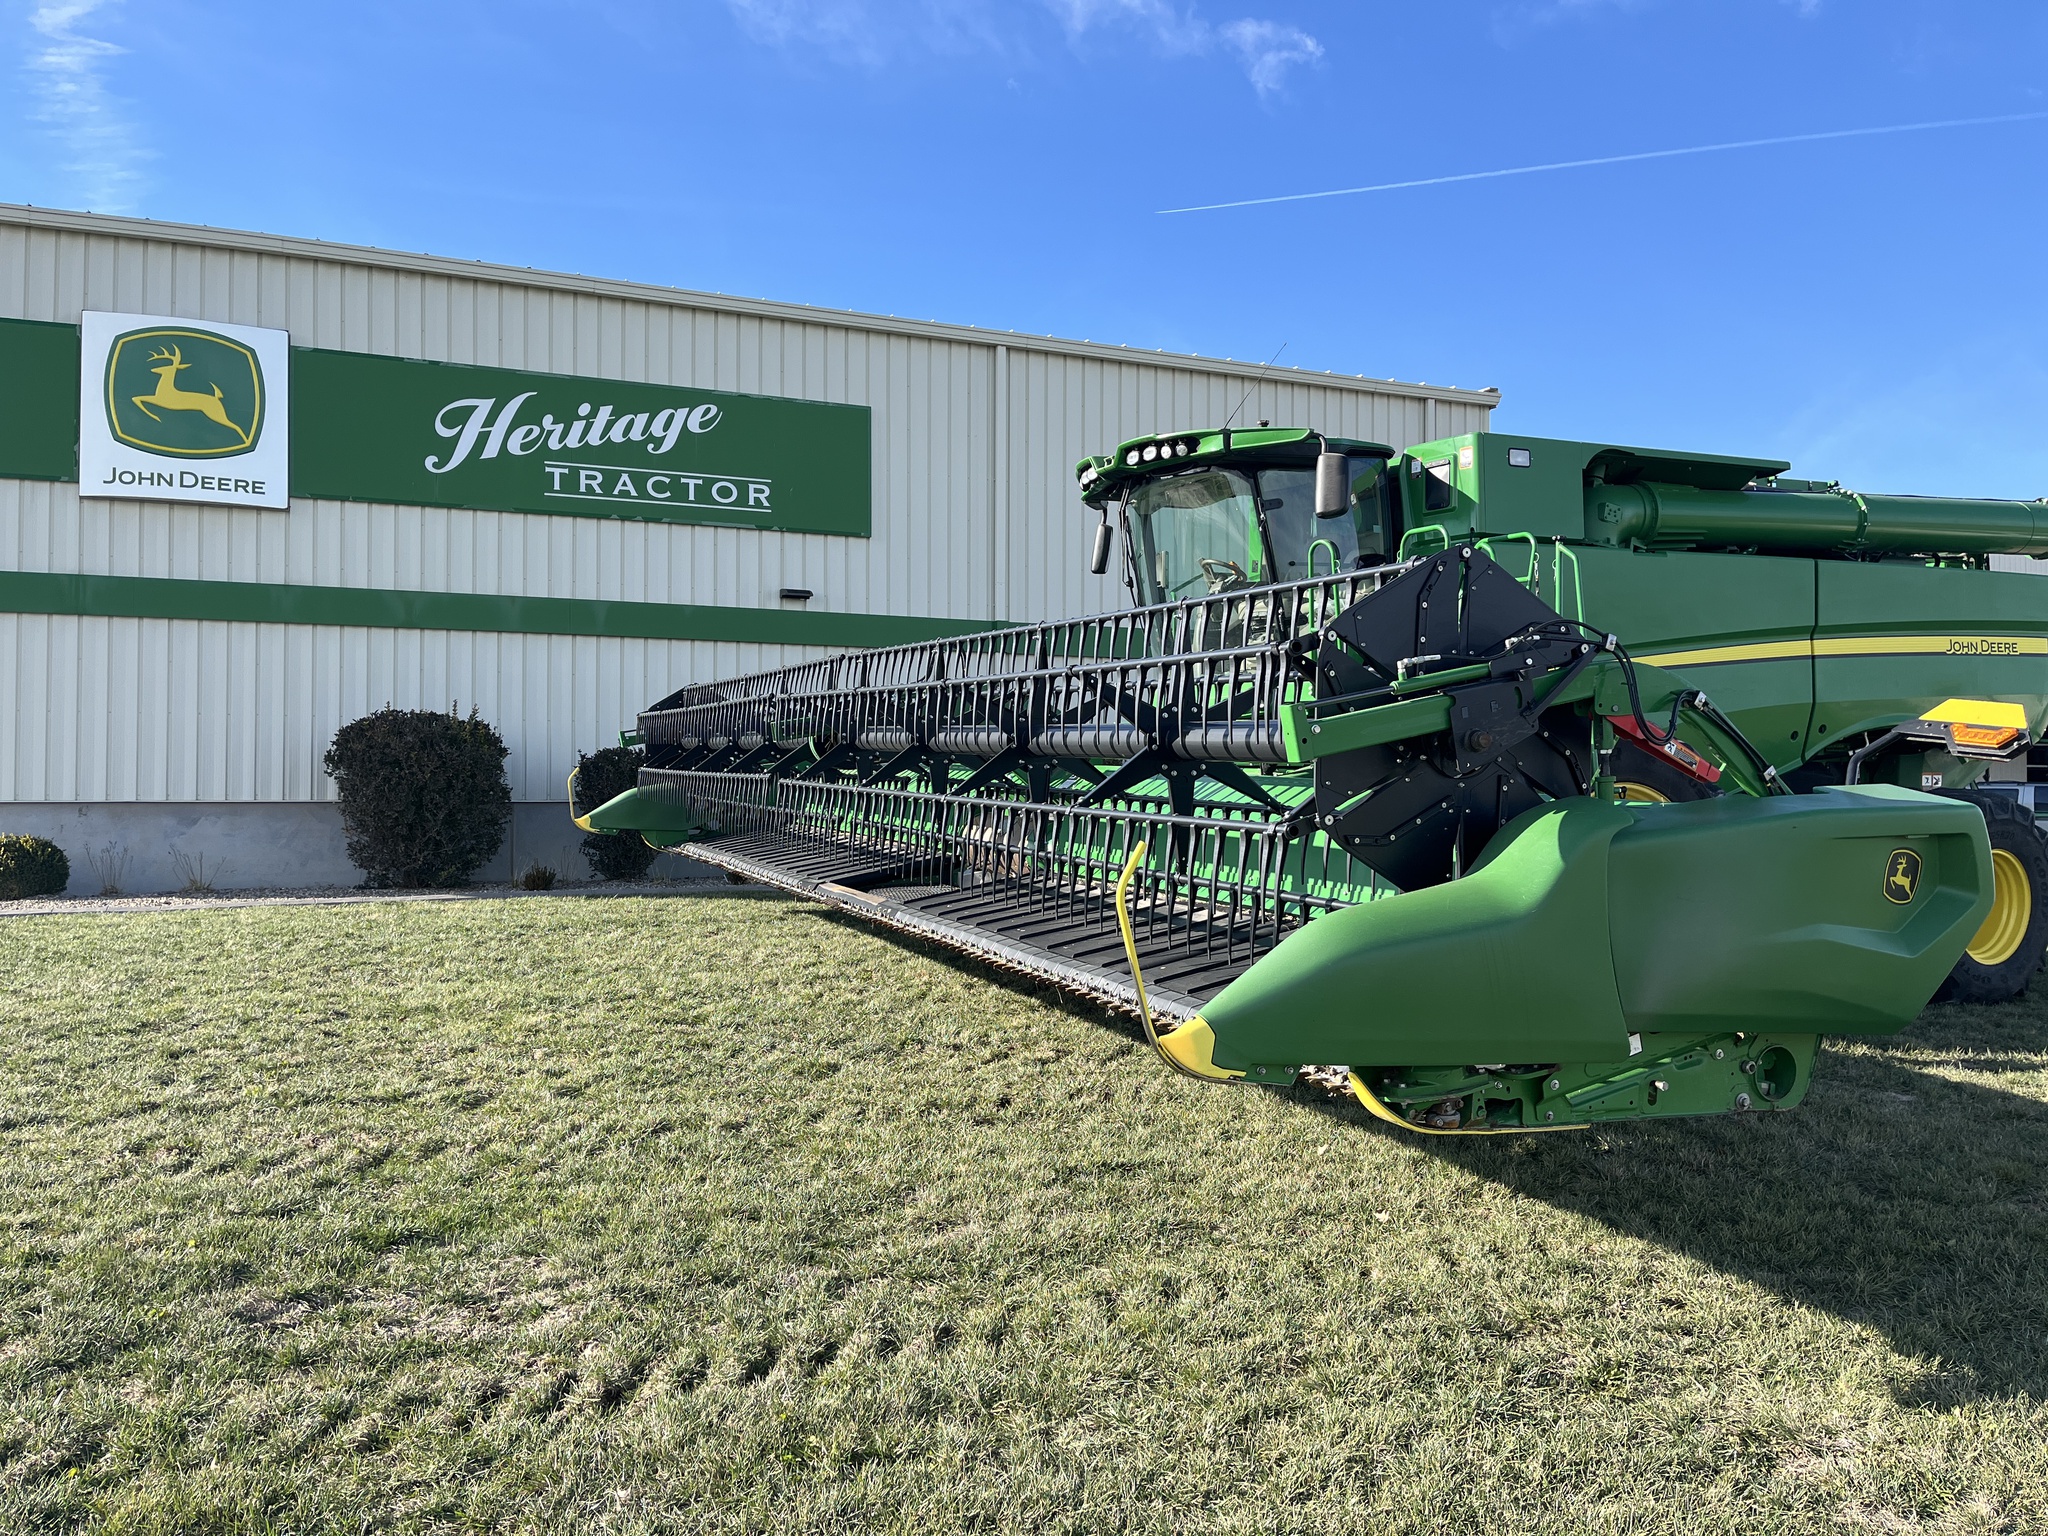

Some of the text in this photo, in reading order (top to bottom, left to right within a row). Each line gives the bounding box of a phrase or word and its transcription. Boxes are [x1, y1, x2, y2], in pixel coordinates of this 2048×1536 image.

[424, 391, 723, 474] Heritage
[102, 467, 266, 495] JOHN DEERE
[544, 465, 771, 507] TRACTOR
[1946, 638, 2018, 653] JOHN DEERE
